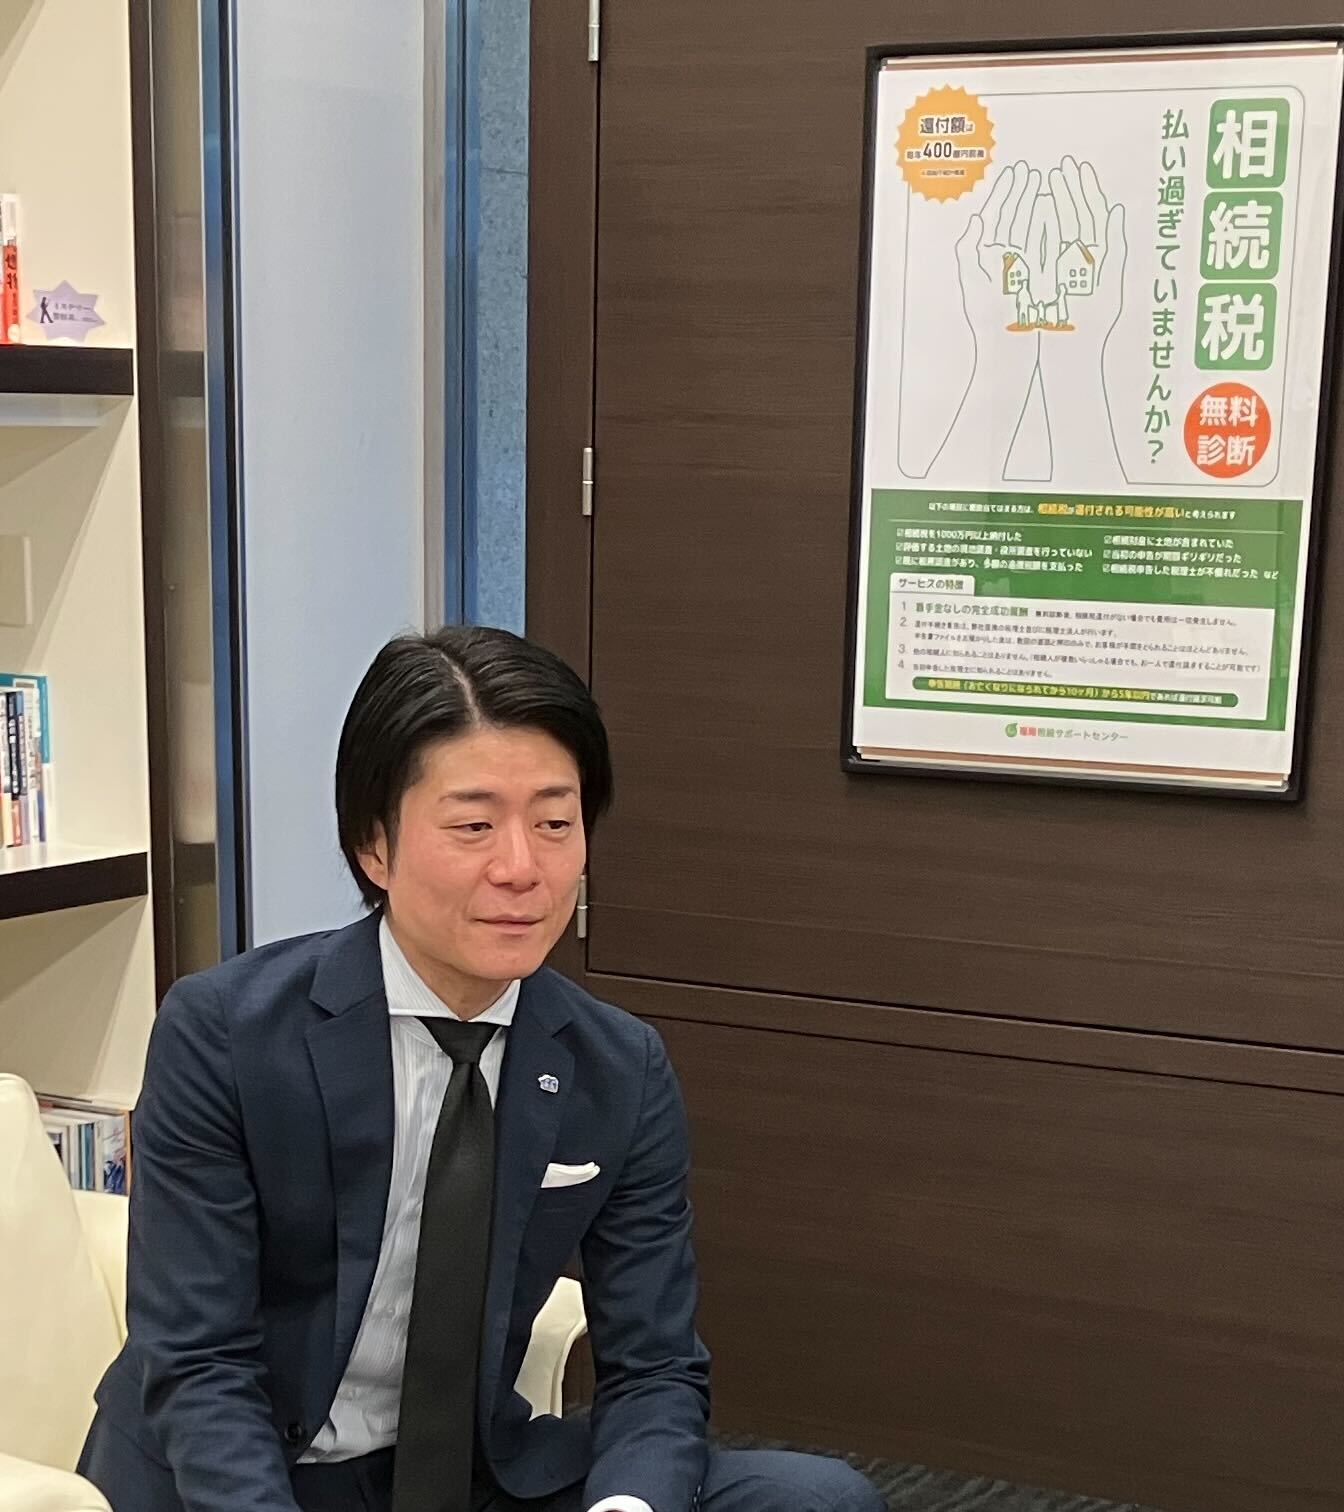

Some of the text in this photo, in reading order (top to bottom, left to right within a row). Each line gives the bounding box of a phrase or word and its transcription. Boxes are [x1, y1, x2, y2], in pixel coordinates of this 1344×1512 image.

[1144, 109, 1189, 464] 払い過ぎていませんか？
[1201, 109, 1277, 361] 相続税
[1197, 433, 1256, 466] 診断
[1199, 394, 1258, 427] 無料
